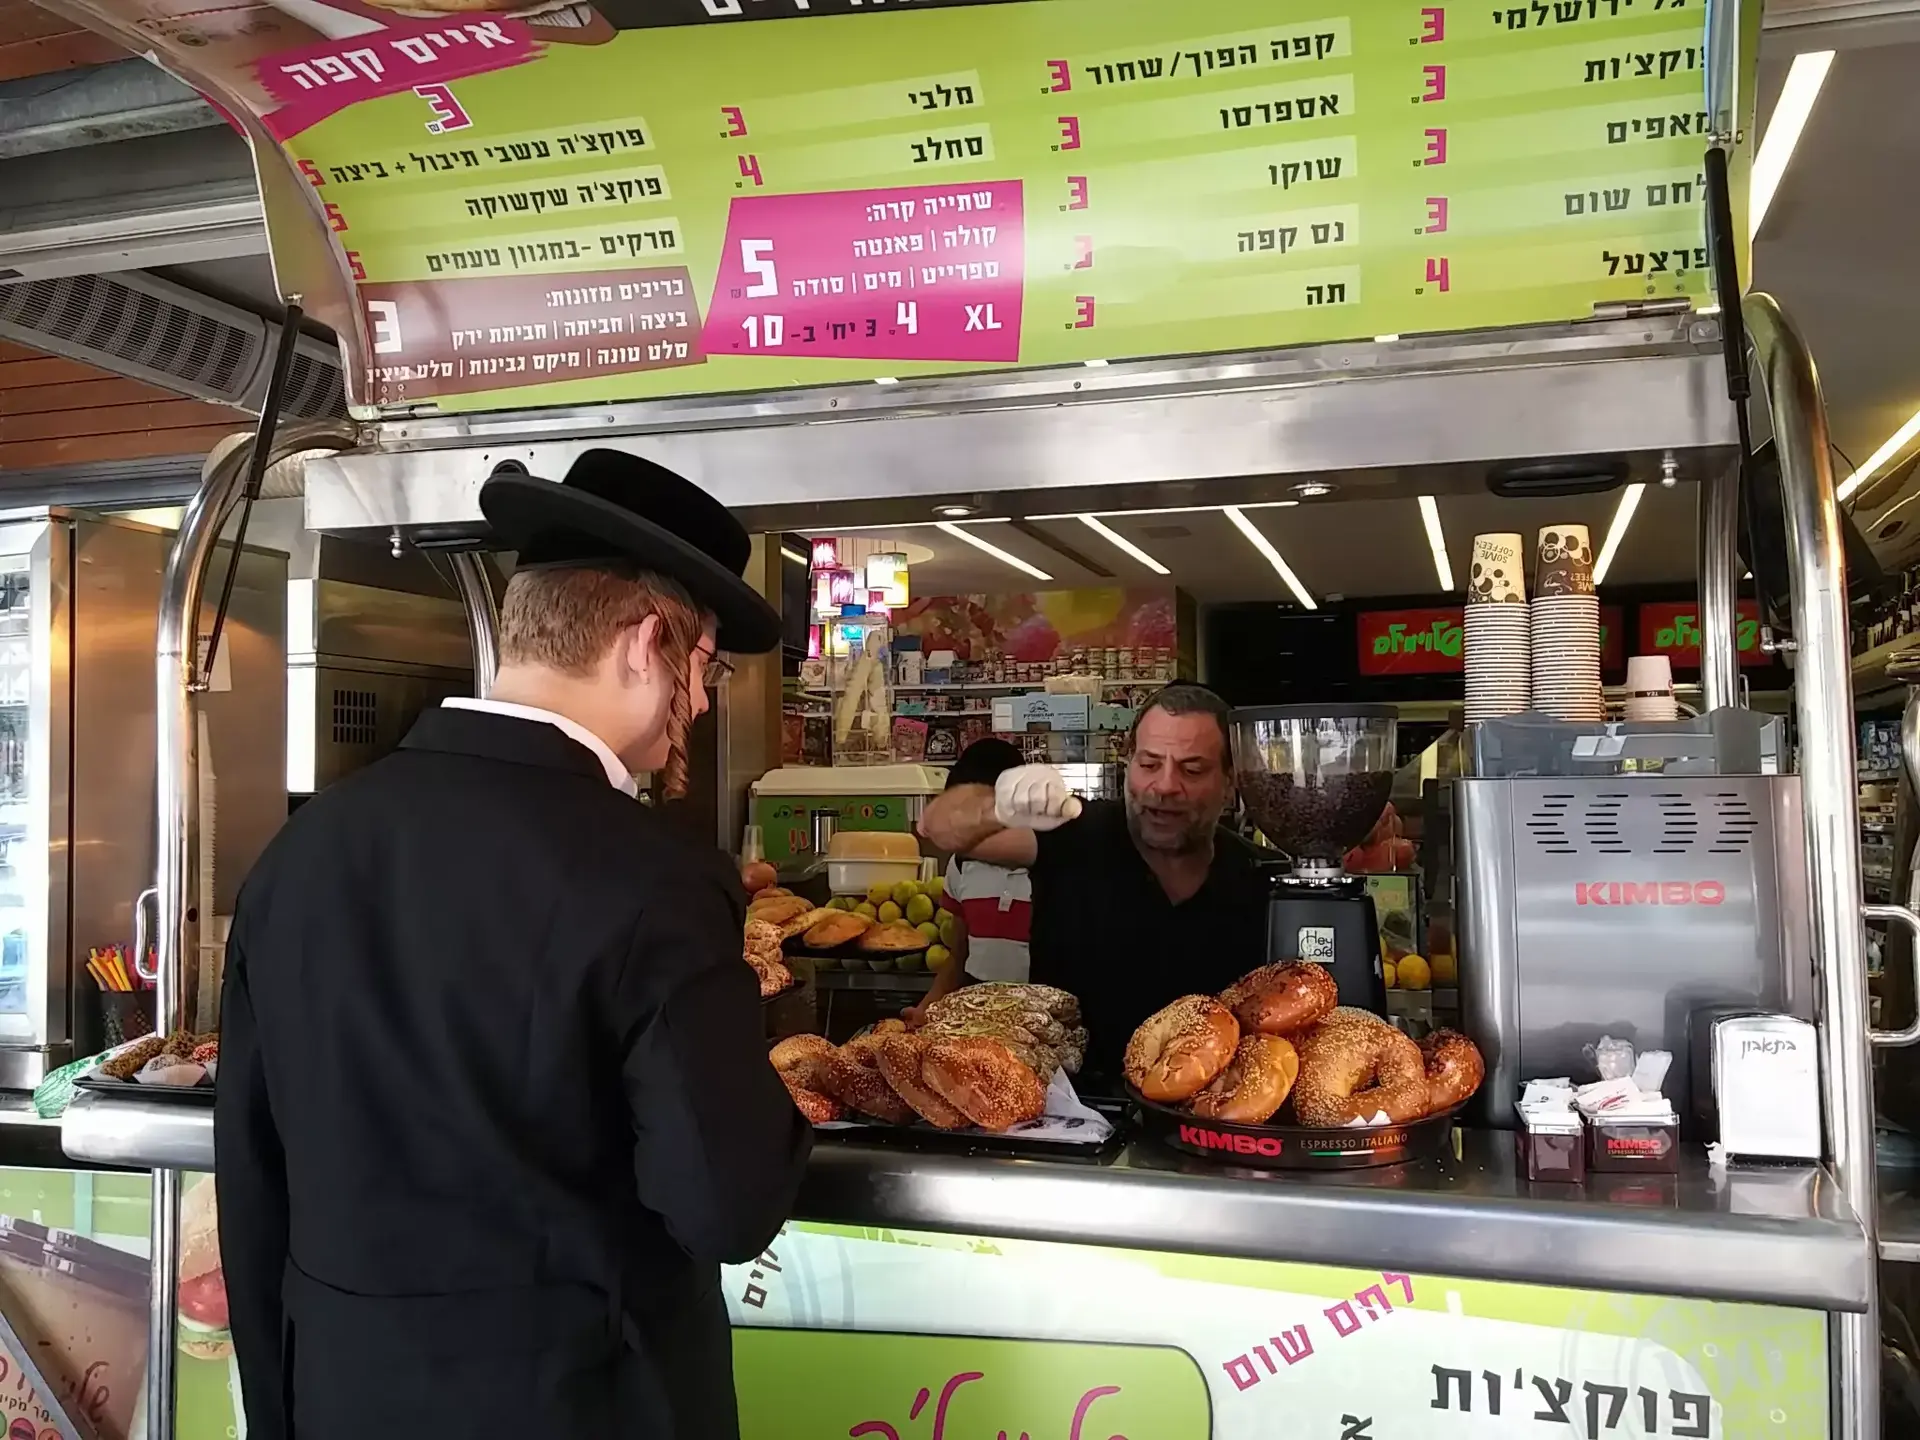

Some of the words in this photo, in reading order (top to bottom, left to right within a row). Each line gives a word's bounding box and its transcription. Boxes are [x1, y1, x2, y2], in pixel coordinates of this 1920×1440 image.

[1420, 7, 1445, 44] 3
[389, 20, 516, 65] איים
[1270, 32, 1336, 61] קפה
[279, 46, 386, 90] קפה
[1046, 59, 1072, 93] 3
[1583, 46, 1705, 83] וקצ'ות
[908, 83, 975, 110] מלבי
[1421, 65, 1447, 102] 3
[721, 106, 748, 137] 3
[1219, 93, 1340, 130] אספרסו
[911, 133, 984, 163] סחלב
[1057, 116, 1082, 151] 3
[1423, 128, 1448, 166] 3
[409, 147, 479, 176] תיבול
[484, 138, 552, 169] עשבי
[329, 161, 389, 184] ביצה
[737, 154, 764, 186] 4
[1268, 156, 1342, 190] שוקו
[464, 183, 568, 218] שקשוקה
[922, 190, 993, 216] שתייה
[1067, 175, 1089, 211] 3
[1564, 187, 1631, 216] שום
[865, 199, 916, 223] קרה:
[1425, 197, 1449, 234] 3
[600, 228, 676, 256] מרקים
[852, 233, 924, 258] פאנטה
[942, 223, 997, 249] קולה
[1237, 225, 1298, 254] קפה
[1311, 220, 1345, 245] נס
[426, 248, 501, 273] טעמים
[739, 239, 779, 299] 5
[921, 260, 1000, 285] ספרייט
[1425, 257, 1450, 292] 4
[1602, 247, 1712, 277] פרצעל
[618, 278, 684, 302] כריכים
[792, 275, 845, 298] סודה
[863, 270, 902, 291] מים
[1306, 282, 1346, 306] תה
[367, 299, 403, 354] 3
[563, 315, 624, 337] חביתה
[640, 309, 688, 330] ביצה
[895, 300, 918, 335] 4
[963, 302, 1003, 332] XL
[1075, 295, 1095, 329] 3
[451, 327, 482, 351] ירק
[488, 320, 548, 344] חביתת
[741, 313, 785, 349] 10
[864, 318, 877, 338] 3
[532, 349, 580, 374] מיקס
[597, 344, 640, 365] טונה
[647, 339, 689, 361] סלט
[416, 358, 453, 379] סלט
[468, 354, 526, 376] גבינות
[1575, 880, 1726, 907] KIMBO
[1306, 930, 1333, 951] Hey
[1741, 1036, 1797, 1060] בתאבון
[1180, 1124, 1282, 1157] KIMBO
[1300, 1136, 1356, 1150] ESPRESSO
[1360, 1132, 1408, 1148] ITALIANO
[1607, 1139, 1662, 1150] KIMBO
[1322, 1271, 1415, 1338] לחם
[1222, 1323, 1315, 1391] שום
